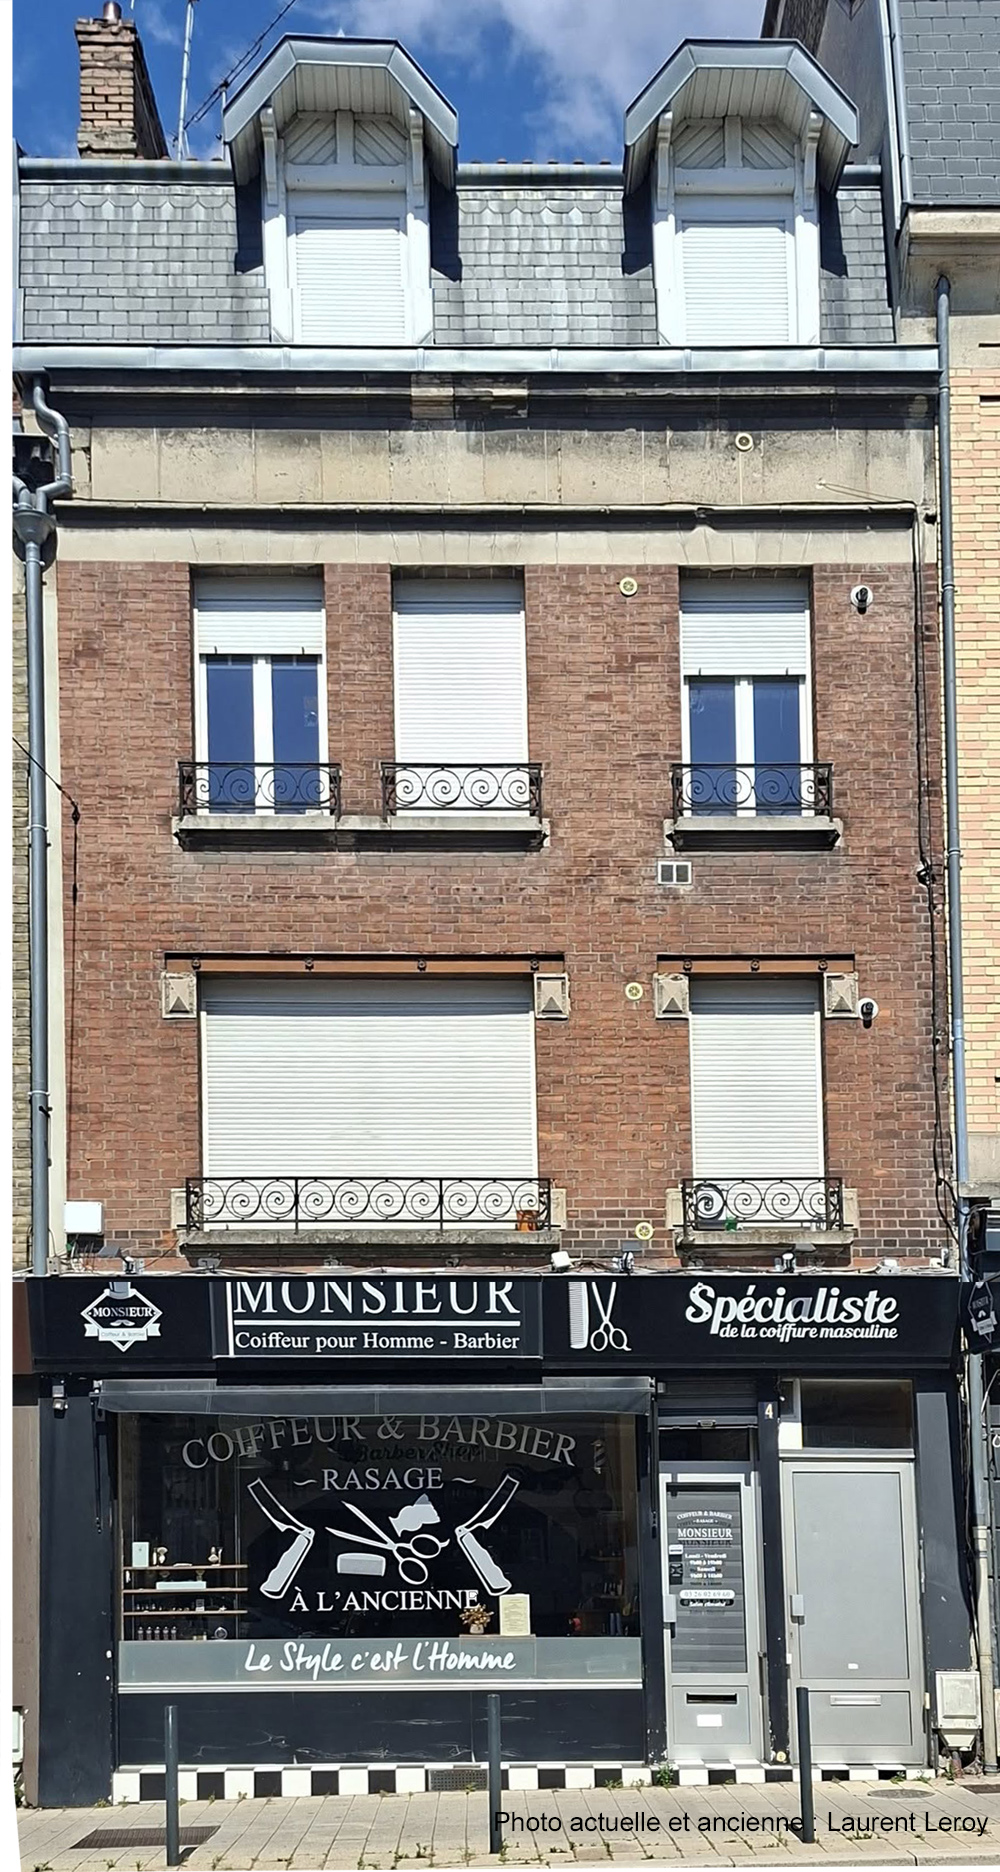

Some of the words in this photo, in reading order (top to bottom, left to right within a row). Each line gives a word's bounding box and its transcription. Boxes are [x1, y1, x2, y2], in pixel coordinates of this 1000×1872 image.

[233, 1281, 521, 1315] MONSIEUR
[685, 1282, 899, 1335] Spécialiste
[92, 1307, 153, 1317] MONSIEUR
[235, 1331, 311, 1350] Coiffeur
[315, 1336, 359, 1356] pour
[363, 1332, 435, 1350] Homme
[453, 1332, 520, 1350] Barbier
[719, 1322, 737, 1338] de
[740, 1323, 757, 1338] la
[759, 1323, 819, 1343] coiffure
[820, 1324, 898, 1340] masculine
[764, 1403, 774, 1420] 4
[182, 1415, 366, 1470] COIFFEUR
[377, 1414, 404, 1440] &
[417, 1414, 577, 1467] BARBIER
[321, 1468, 444, 1491] RASAGE
[677, 1528, 733, 1538] MONSIEUR
[289, 1585, 310, 1612] À
[317, 1589, 481, 1613] L'ANCIENNE
[245, 1644, 272, 1673] Le
[280, 1642, 343, 1680] Style
[350, 1644, 406, 1673] c'est
[412, 1641, 517, 1673] l'Homme
